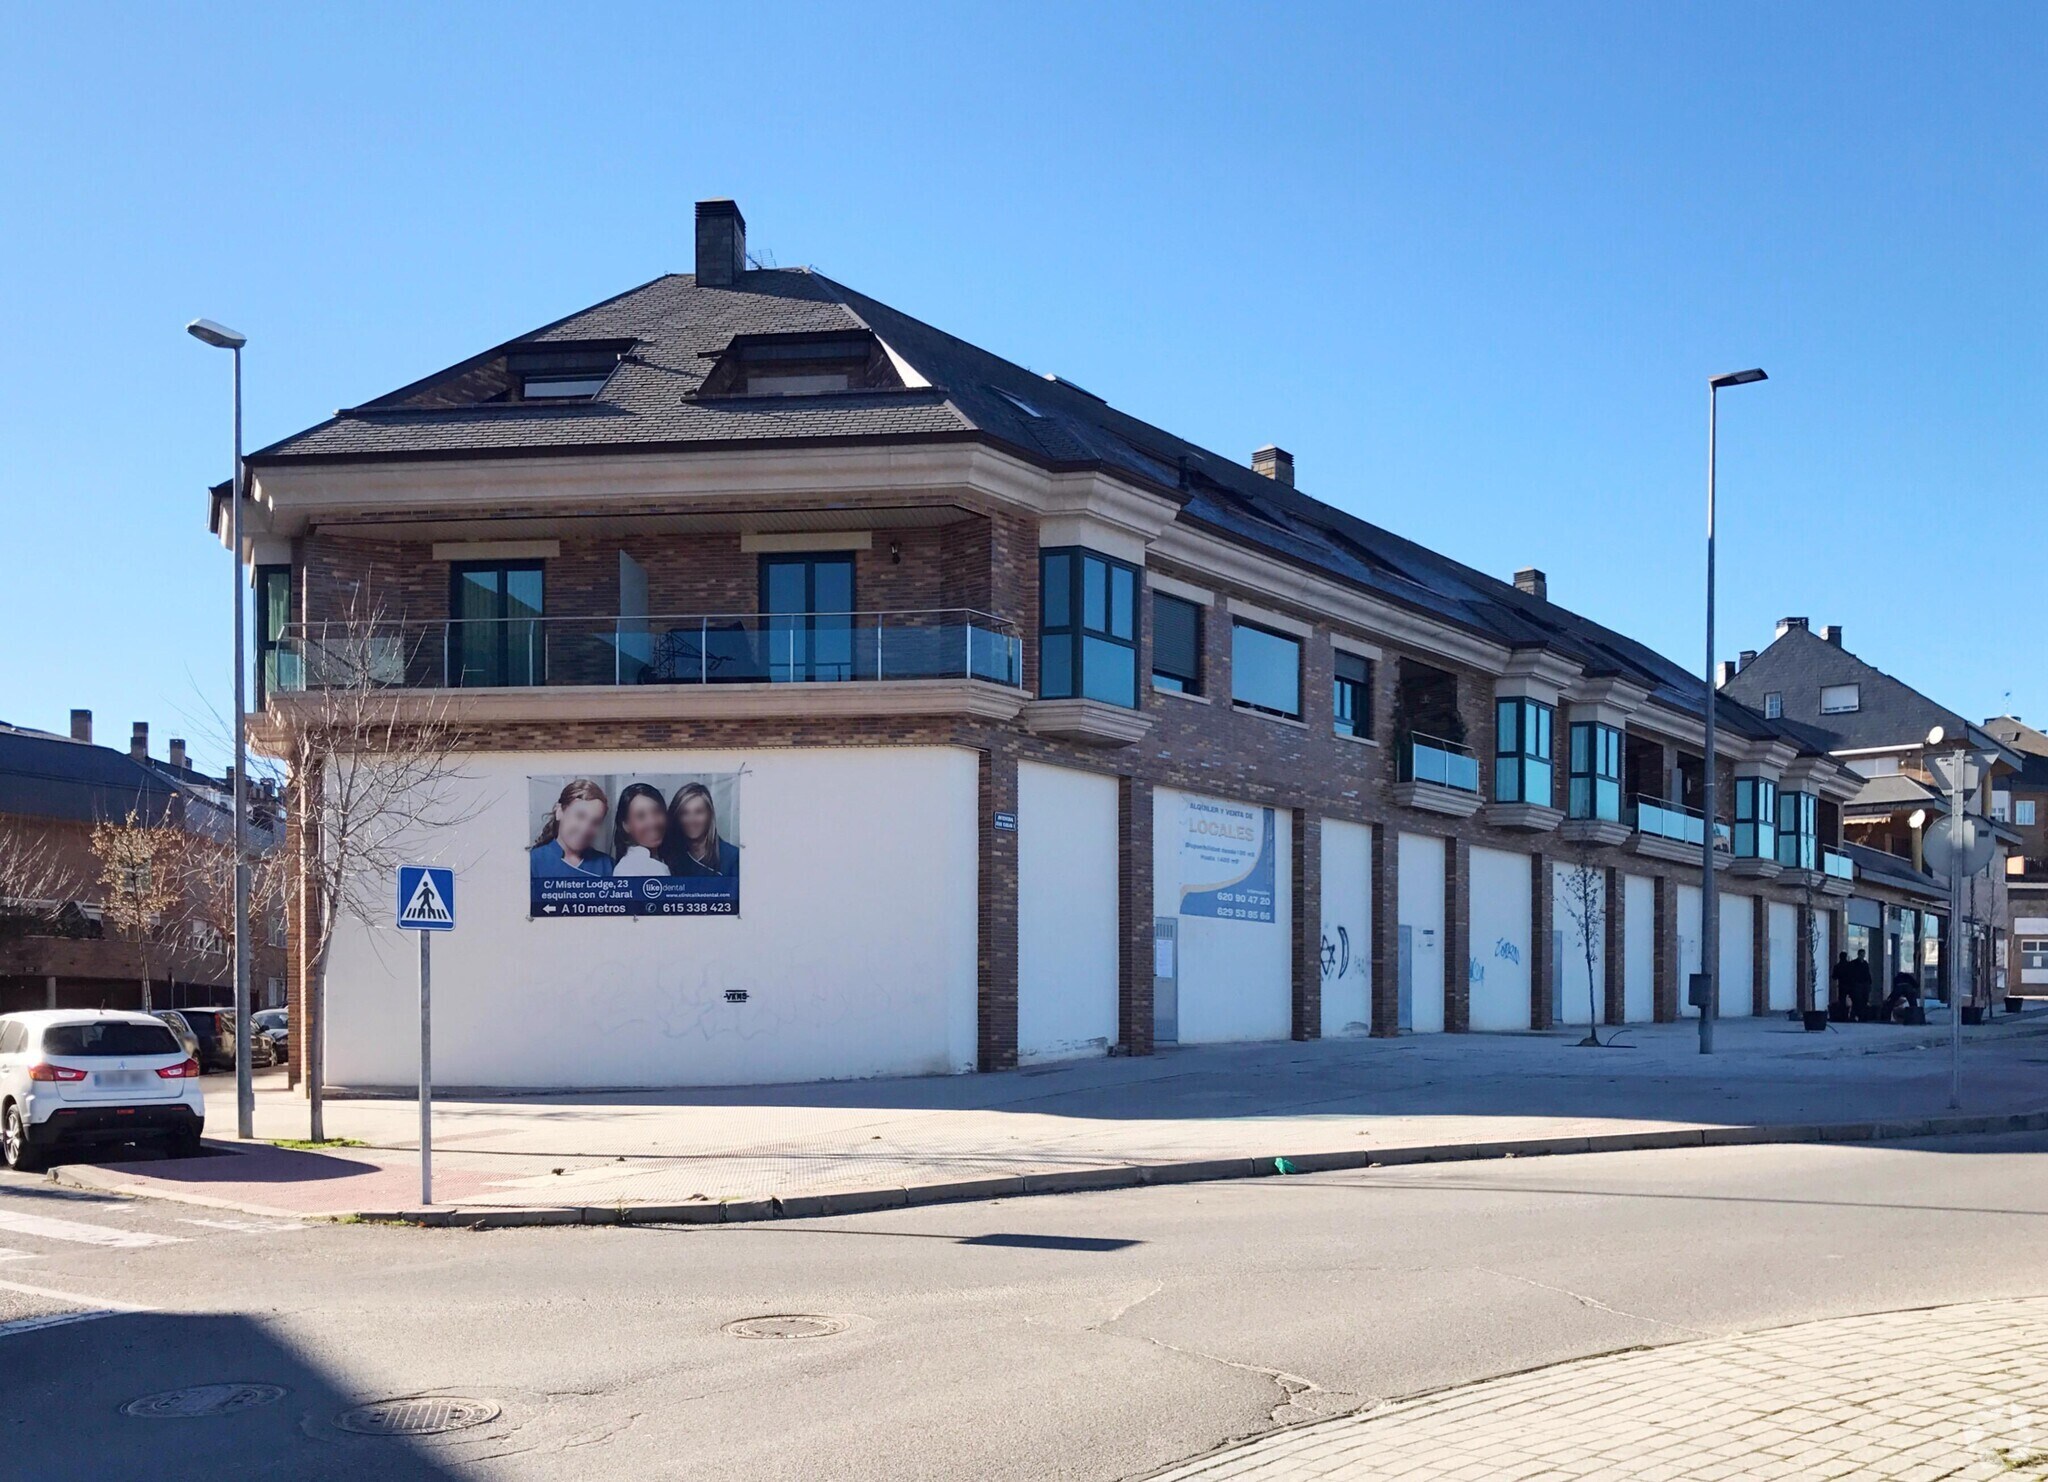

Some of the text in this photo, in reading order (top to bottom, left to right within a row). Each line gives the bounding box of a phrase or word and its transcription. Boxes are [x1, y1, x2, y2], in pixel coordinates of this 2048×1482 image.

[1190, 802, 1219, 814] ALQUILER
[1225, 808, 1244, 818] VENTA
[1245, 812, 1254, 820] DE
[1188, 817, 1255, 842] LOCALES
[543, 879, 629, 891] C/ Mister Lodge, 23
[645, 883, 686, 892] like dental
[541, 890, 633, 901] esquina con C/ Jaral
[1217, 892, 1233, 901] 620
[1247, 895, 1259, 904] 47
[1259, 896, 1271, 906] 20
[561, 903, 626, 913] A 10 metros
[662, 902, 731, 912] 615 338 423
